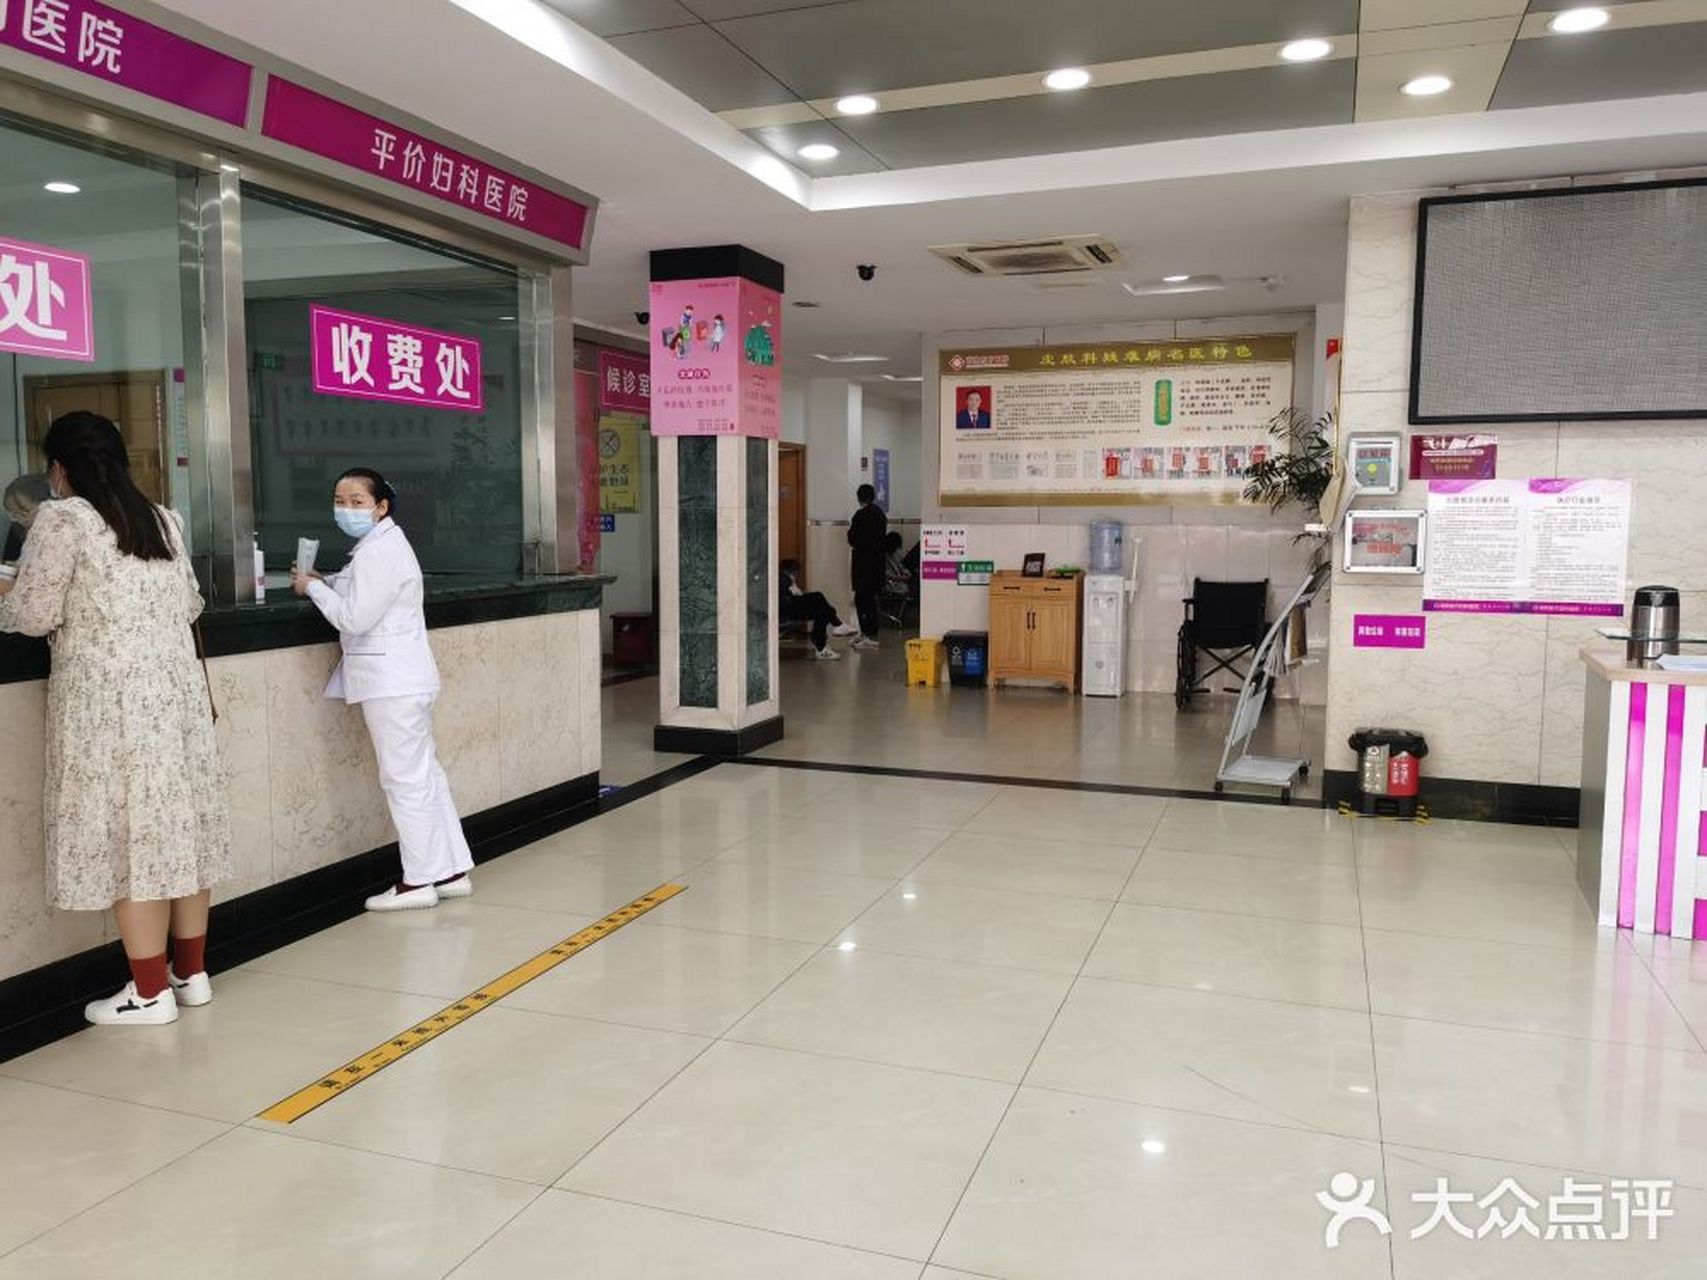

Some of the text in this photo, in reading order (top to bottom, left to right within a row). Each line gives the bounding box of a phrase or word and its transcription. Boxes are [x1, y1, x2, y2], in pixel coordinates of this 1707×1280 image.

[0, 0, 124, 74] 医院
[370, 128, 529, 222] 平价妇科医院
[330, 321, 472, 400] 收费处
[606, 366, 651, 398] 候诊室
